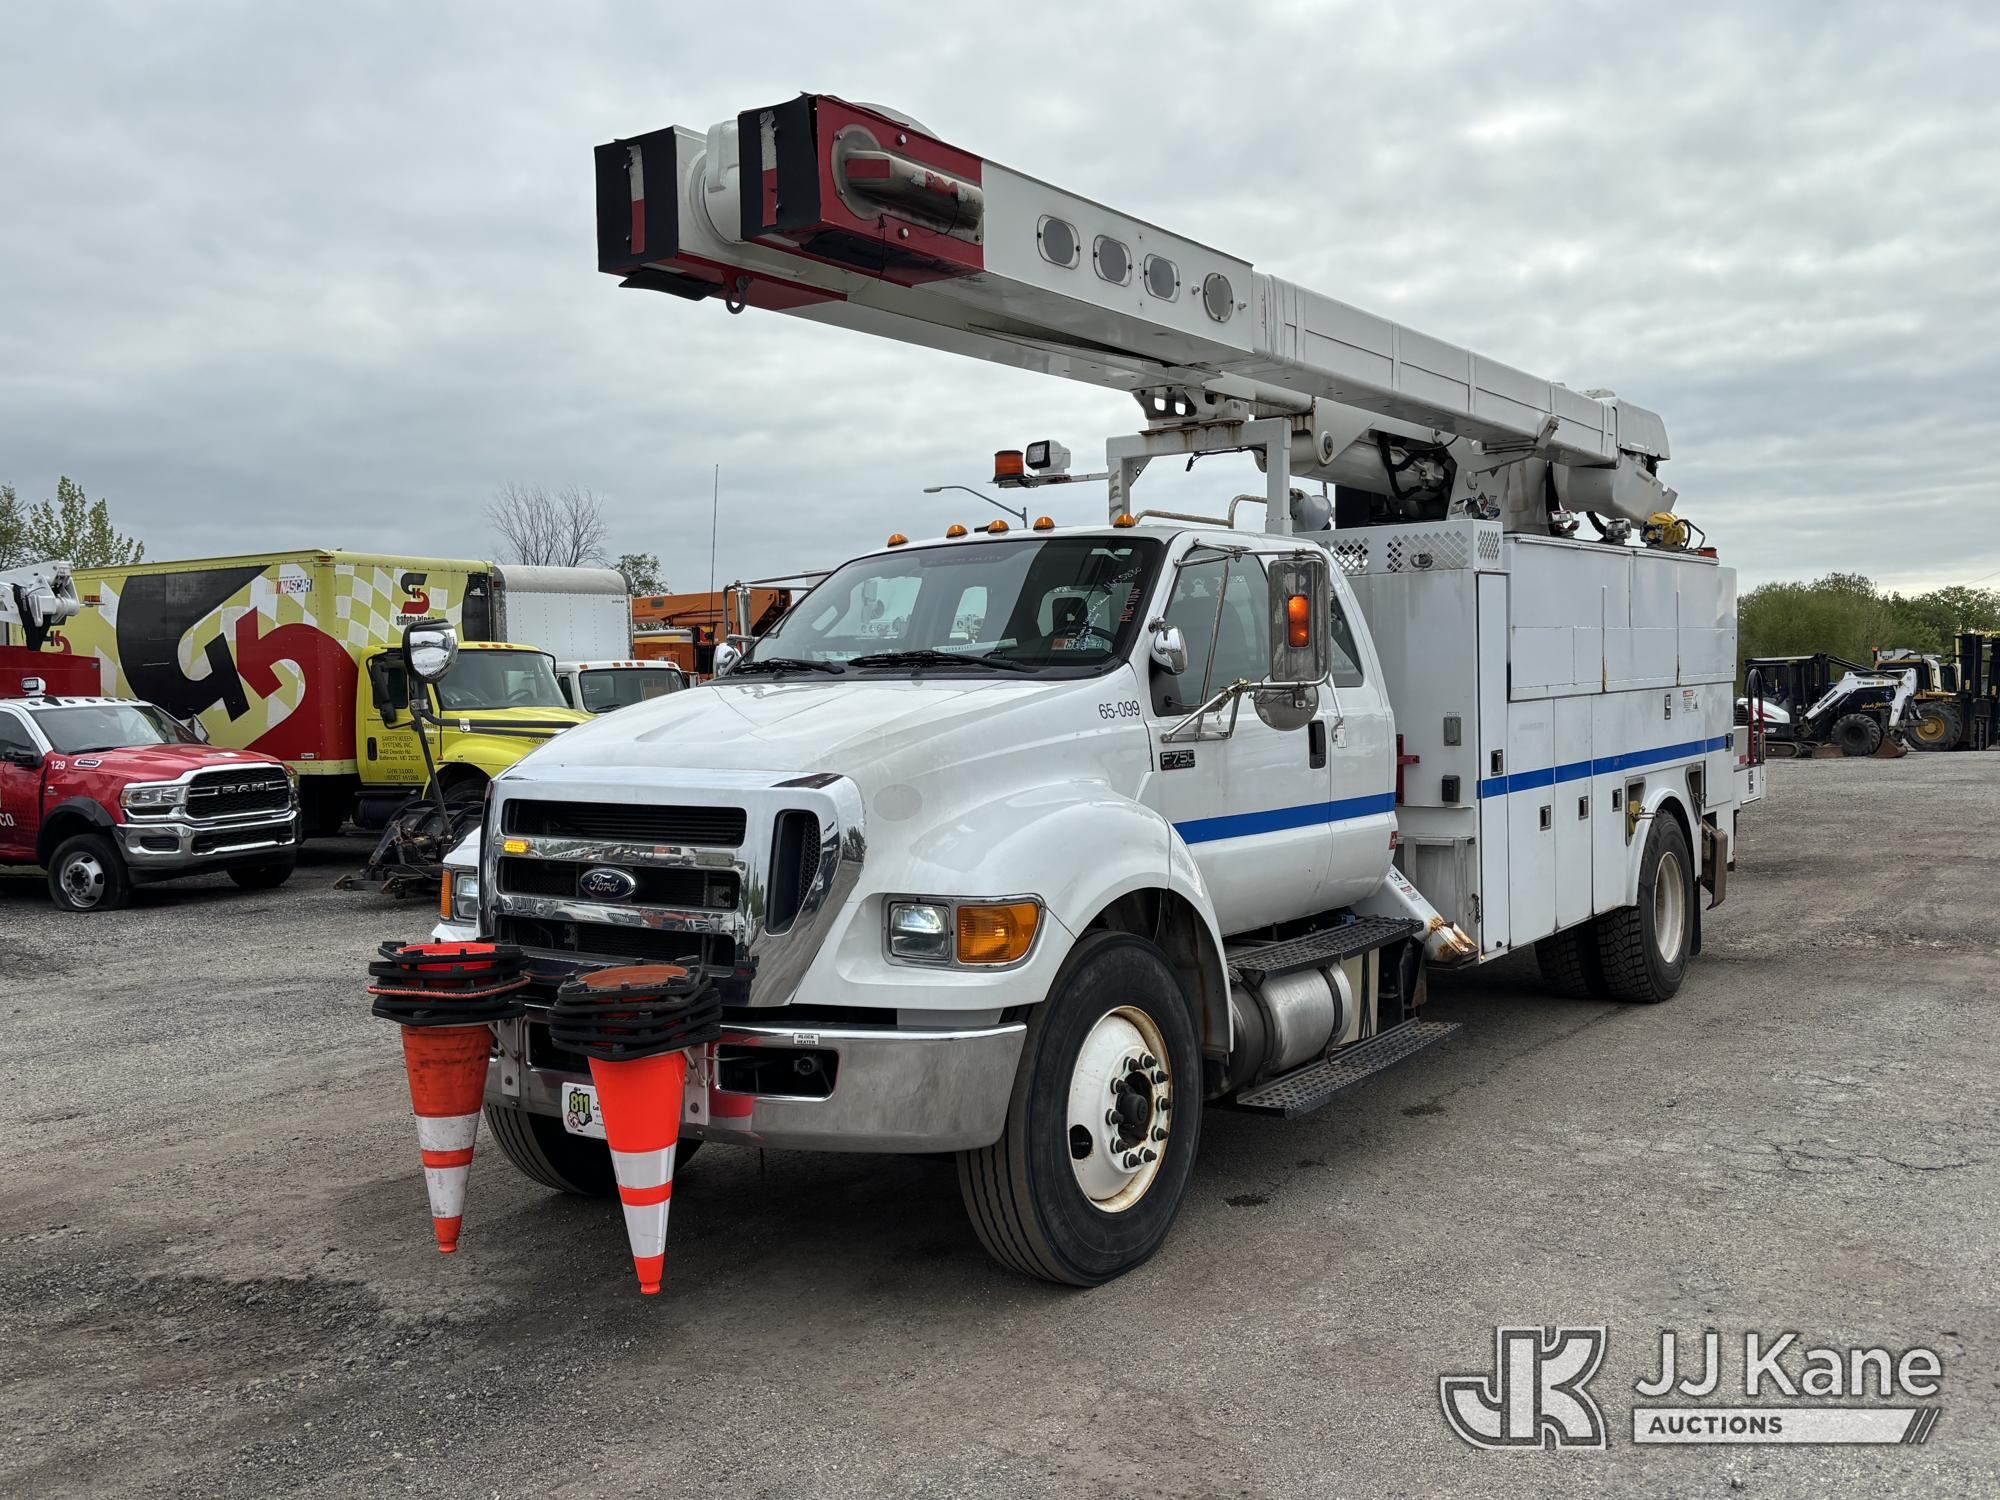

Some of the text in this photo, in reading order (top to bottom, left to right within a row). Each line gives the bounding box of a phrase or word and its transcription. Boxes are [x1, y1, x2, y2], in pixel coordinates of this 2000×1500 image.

[279, 579, 312, 593] NASCAR
[1119, 588, 1142, 622] AUCTION
[1098, 700, 1140, 719] 65-099
[51, 761, 66, 770] 129
[222, 782, 265, 794] RAM
[588, 873, 620, 893] Ford
[569, 1091, 590, 1115] 811
